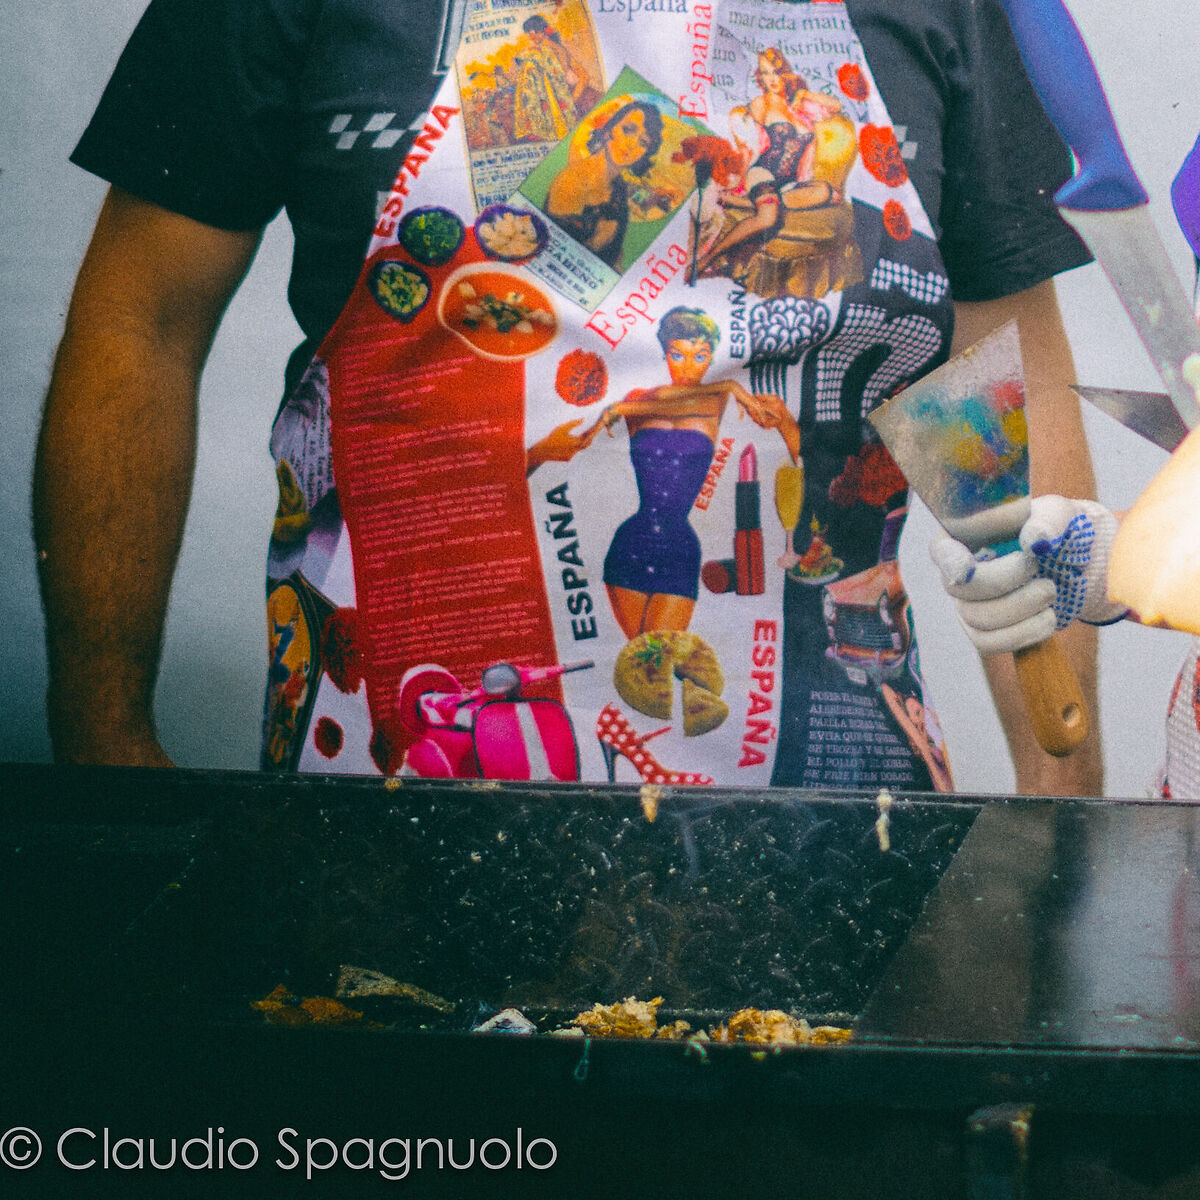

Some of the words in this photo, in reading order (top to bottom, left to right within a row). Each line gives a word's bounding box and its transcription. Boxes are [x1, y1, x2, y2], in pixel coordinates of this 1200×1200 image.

[678, 3, 713, 122] España
[584, 243, 688, 352] España
[545, 481, 598, 641] ESPAÑA
[738, 619, 777, 768] ESPAÑA
